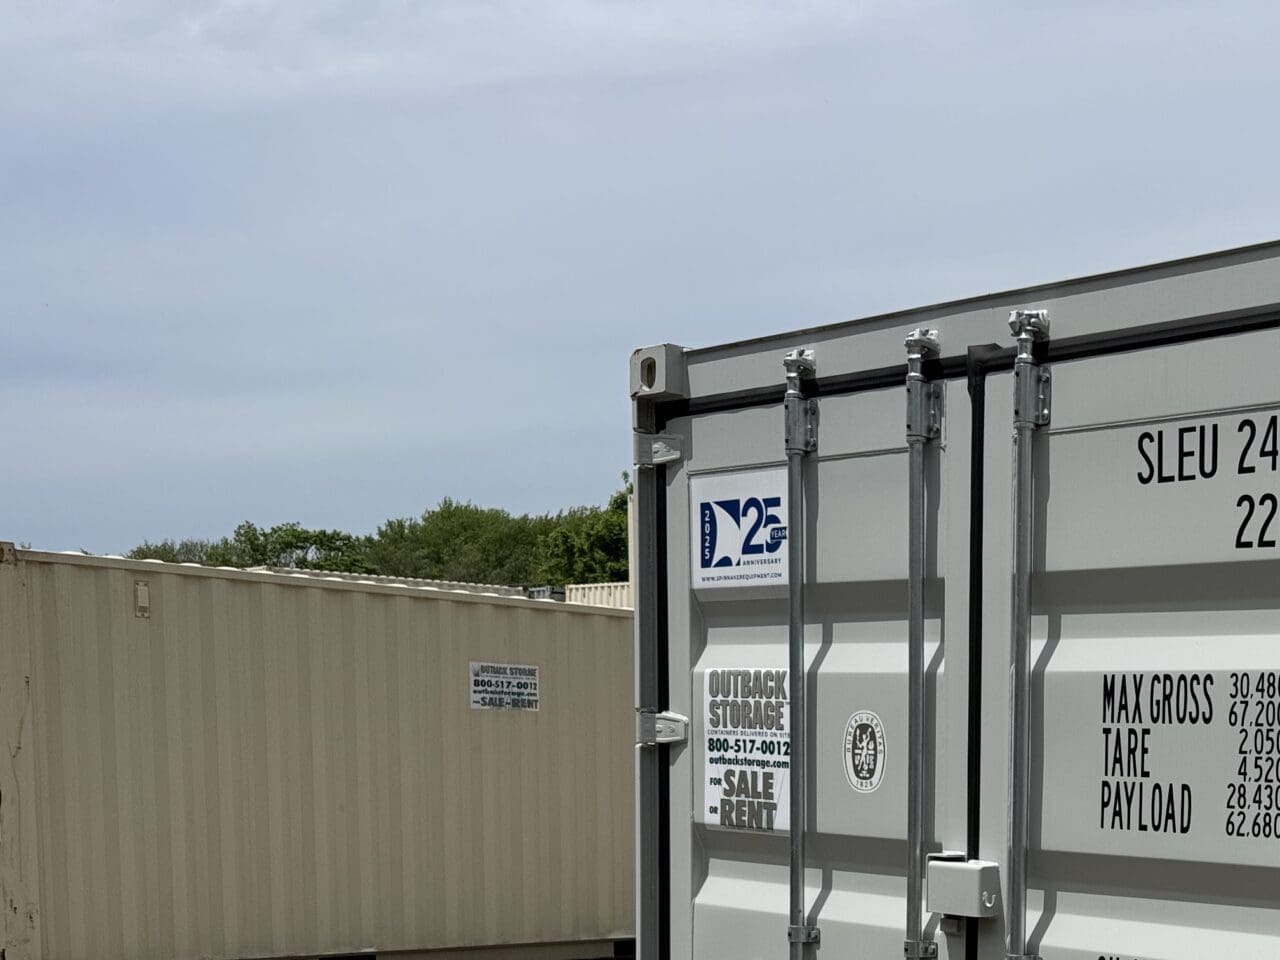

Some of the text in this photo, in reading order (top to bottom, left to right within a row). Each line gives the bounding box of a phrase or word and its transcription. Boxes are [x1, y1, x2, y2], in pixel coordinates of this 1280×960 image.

[1137, 423, 1218, 485] SLEU
[741, 497, 782, 554] 25
[771, 529, 787, 539] YEAR
[742, 558, 782, 566] ANNIVERSARY
[709, 669, 788, 700] OUTBACK
[1102, 673, 1214, 725] MAX GROSS
[709, 699, 785, 730] STORAGE
[708, 738, 790, 756] 800-517-0012
[709, 753, 790, 769] outbackstorage.com
[1102, 728, 1150, 778] TARE
[710, 769, 774, 800] FOR SALE
[709, 799, 777, 831] OR RENT
[1100, 780, 1192, 834] PAYLOAD
